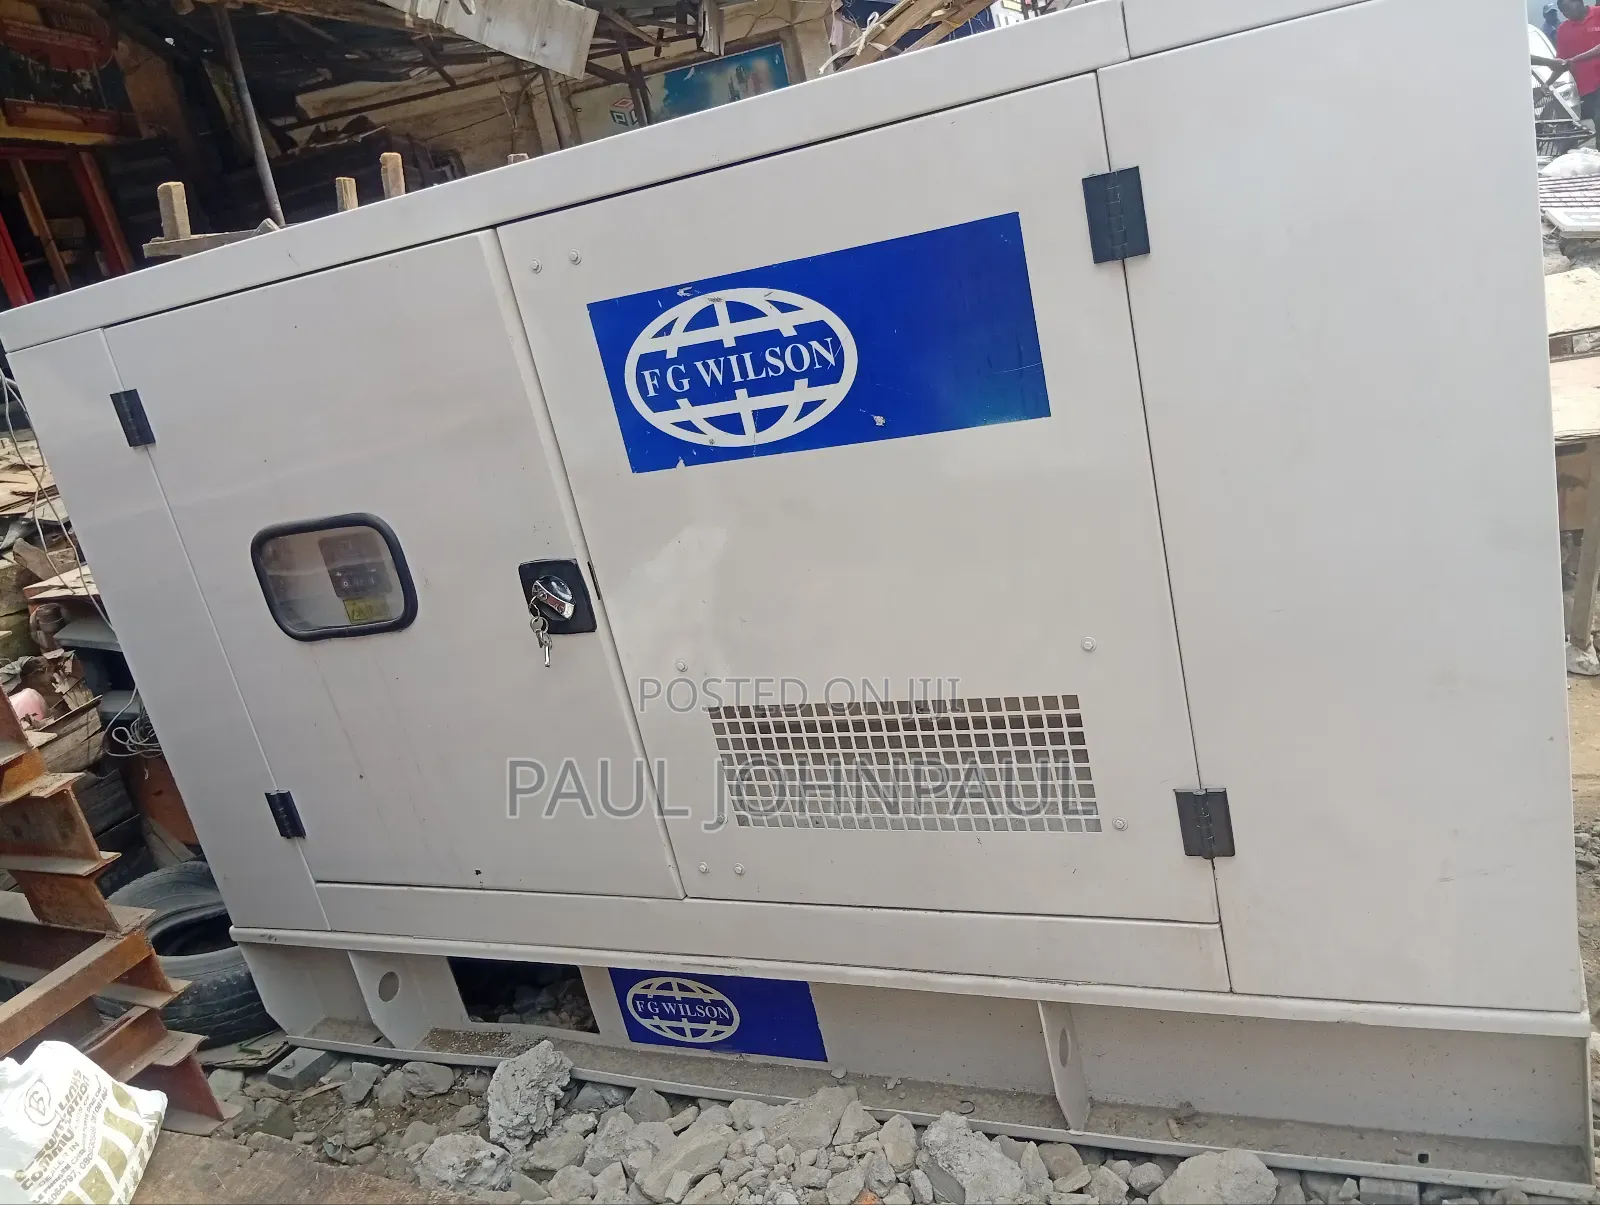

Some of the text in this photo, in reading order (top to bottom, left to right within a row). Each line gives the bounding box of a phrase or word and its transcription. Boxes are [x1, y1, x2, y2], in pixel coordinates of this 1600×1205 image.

[641, 337, 836, 397] FG WILSON
[635, 1000, 730, 1019] FG WILSON
[69, 1141, 80, 1153] IN
